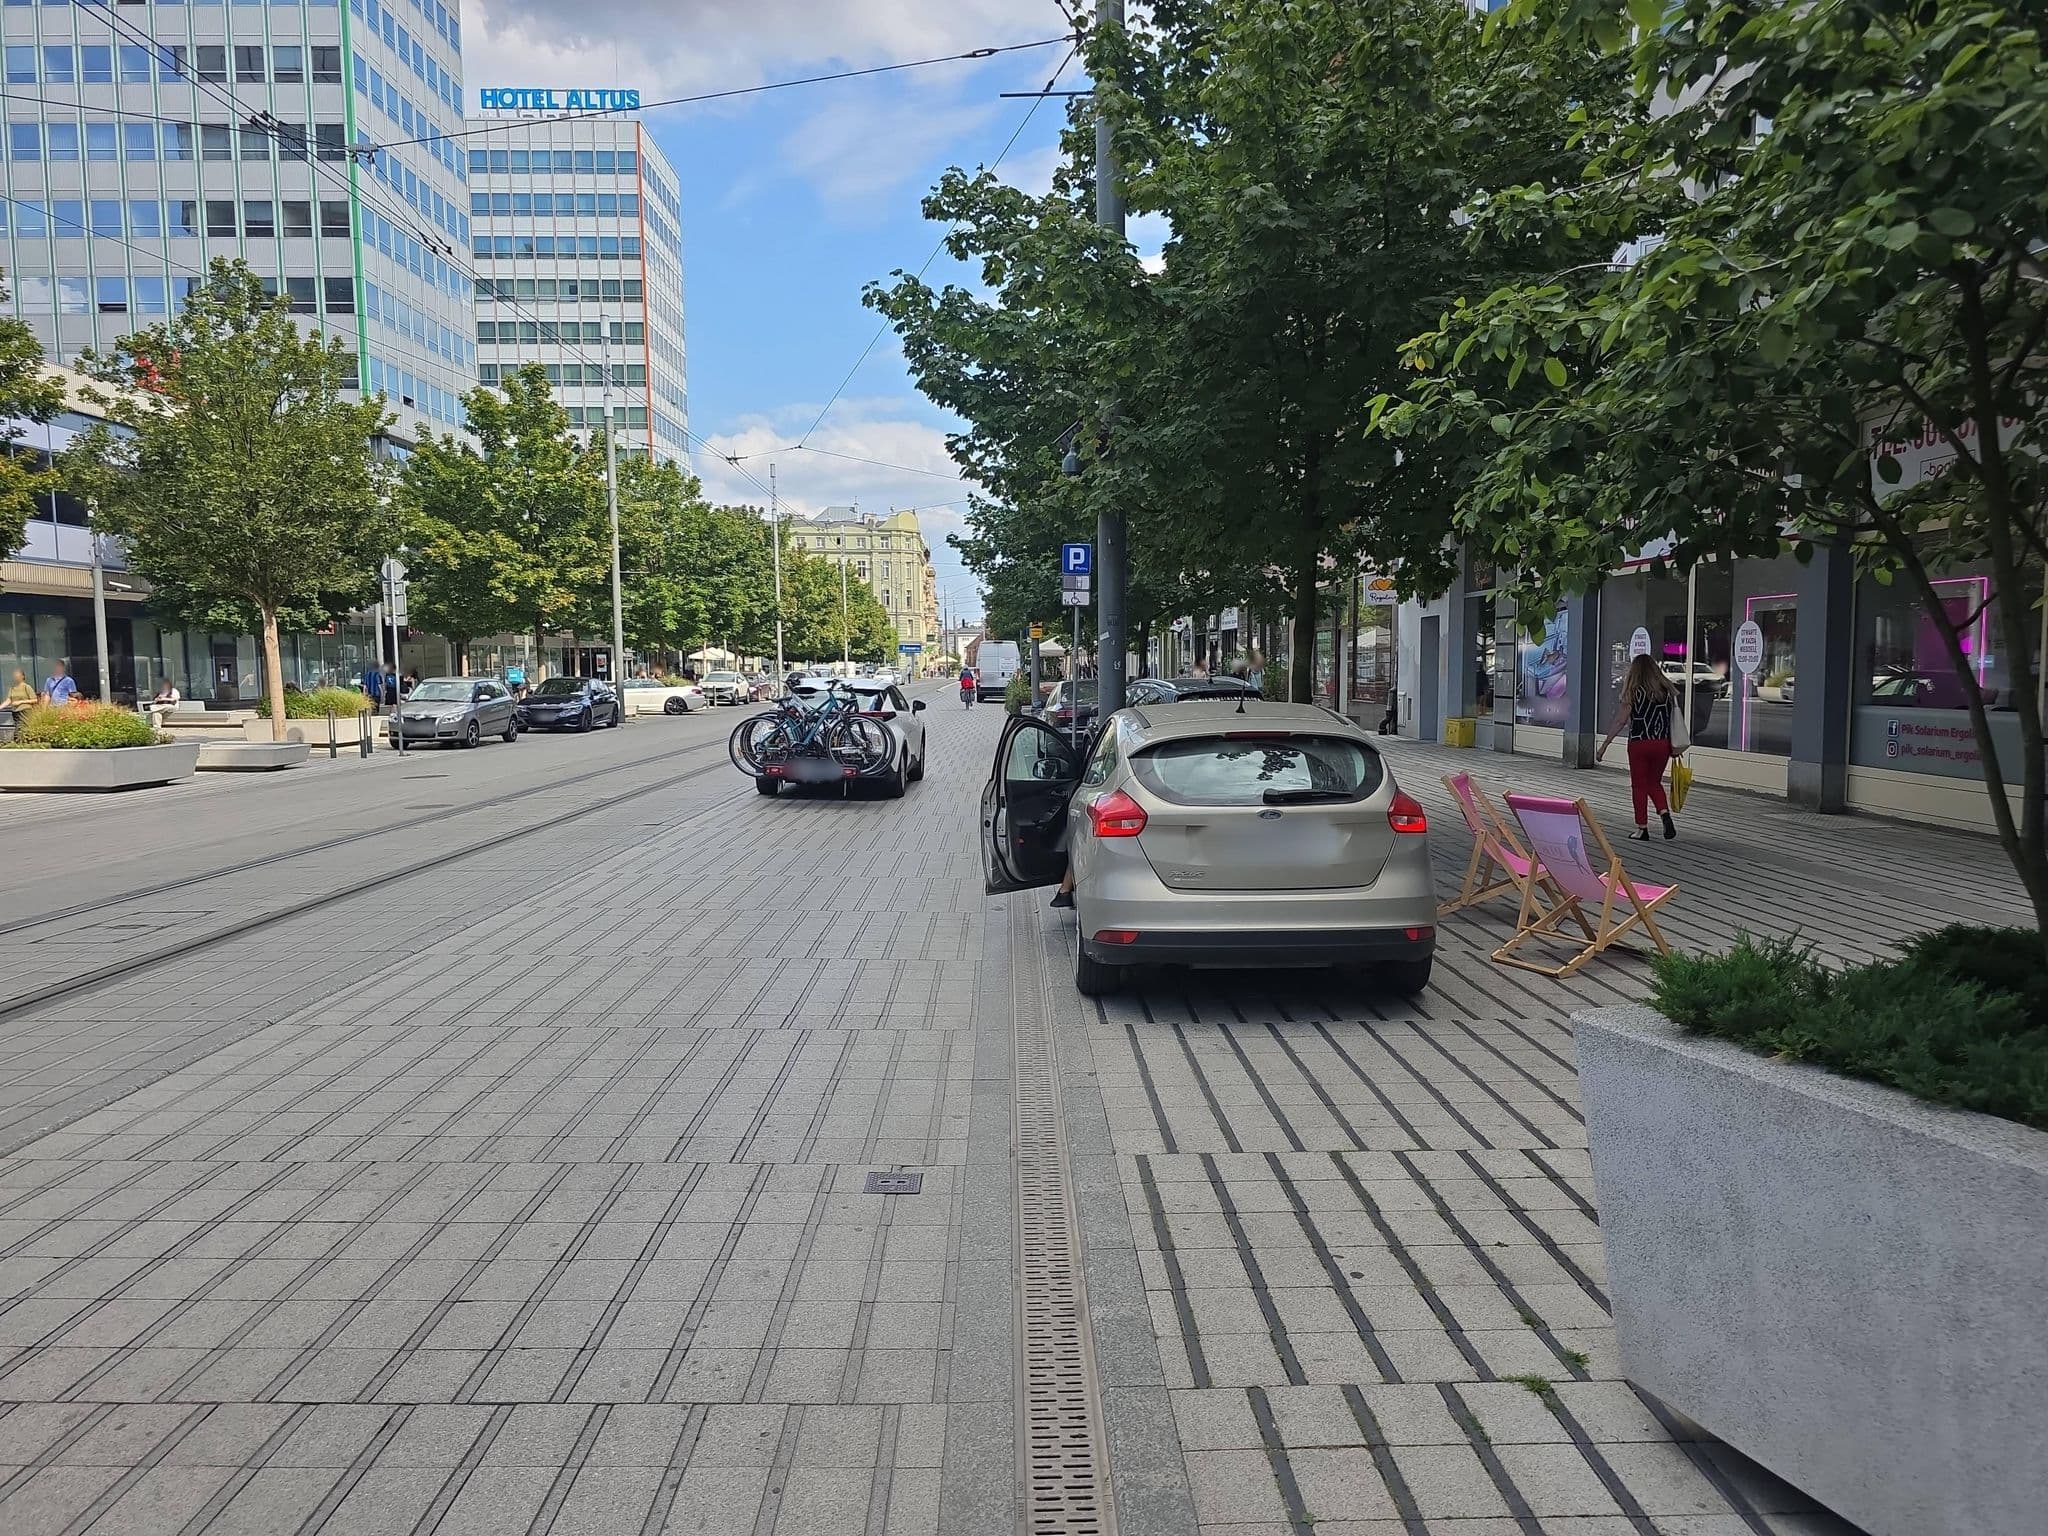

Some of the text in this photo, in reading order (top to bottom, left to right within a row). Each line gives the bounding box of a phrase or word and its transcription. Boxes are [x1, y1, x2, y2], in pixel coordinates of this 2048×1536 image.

[481, 88, 640, 110] HOTEL ALTUS
[1069, 547, 1085, 571] P
[1915, 725, 1949, 737] Solarium
